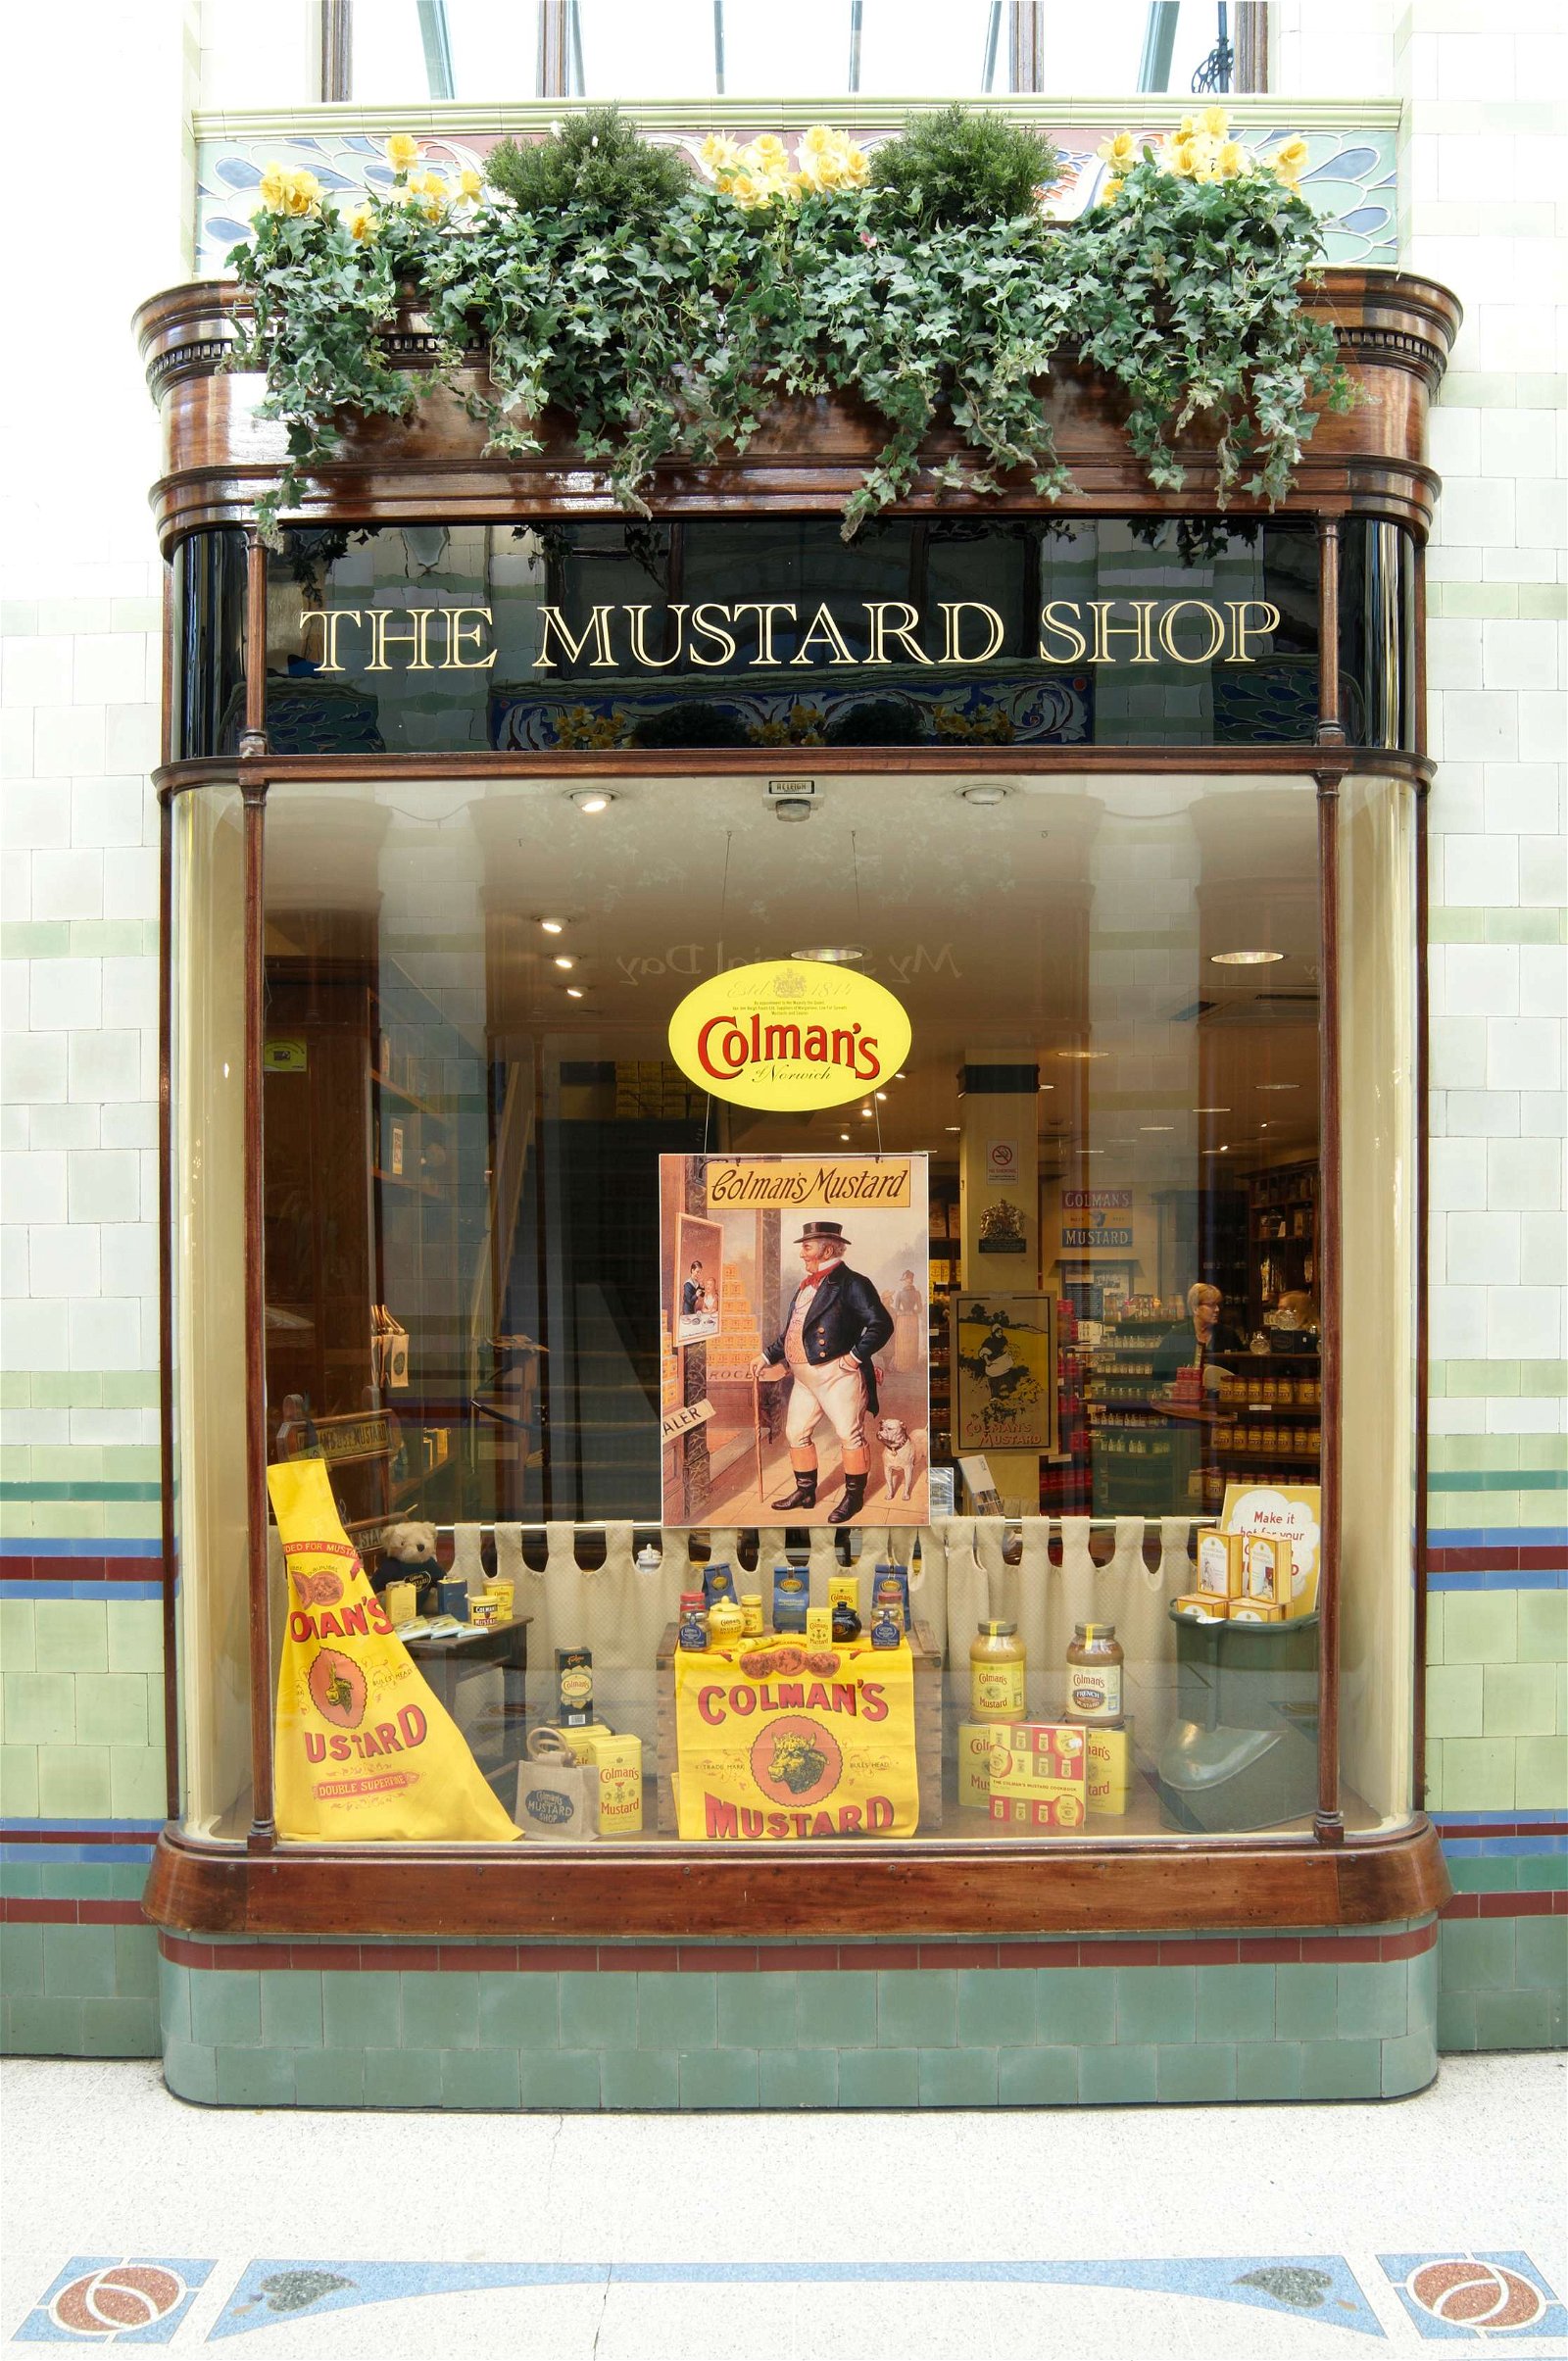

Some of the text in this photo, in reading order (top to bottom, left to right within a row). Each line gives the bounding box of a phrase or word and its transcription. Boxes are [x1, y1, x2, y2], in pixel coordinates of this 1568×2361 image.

[300, 600, 1281, 672] THE MUSTARD SHOP
[698, 1013, 881, 1080] Colman's
[752, 1063, 833, 1083] Norwich
[711, 1167, 908, 1204] Colman's Mustard
[1065, 1192, 1129, 1207] COLMAN'S
[1066, 1230, 1129, 1245] MUSTARD
[979, 1434, 1042, 1448] MUSTARD
[1254, 1510, 1295, 1525] Make it
[564, 1680, 590, 1691] Colman's
[978, 1673, 1007, 1685] Colman's
[1073, 1674, 1105, 1688] Colman's
[1076, 1690, 1100, 1699] FRENCH
[698, 1679, 889, 1726] COLMAN'S
[980, 1697, 1007, 1709] Mustard
[600, 1767, 640, 1783] Colman's
[318, 1774, 407, 1796] DOUBLE SUPERFINE
[528, 1800, 573, 1816] MUSTARD
[601, 1797, 639, 1815] Mustard
[540, 1813, 558, 1822] SHOP
[705, 1792, 895, 1839] MUSTARD
